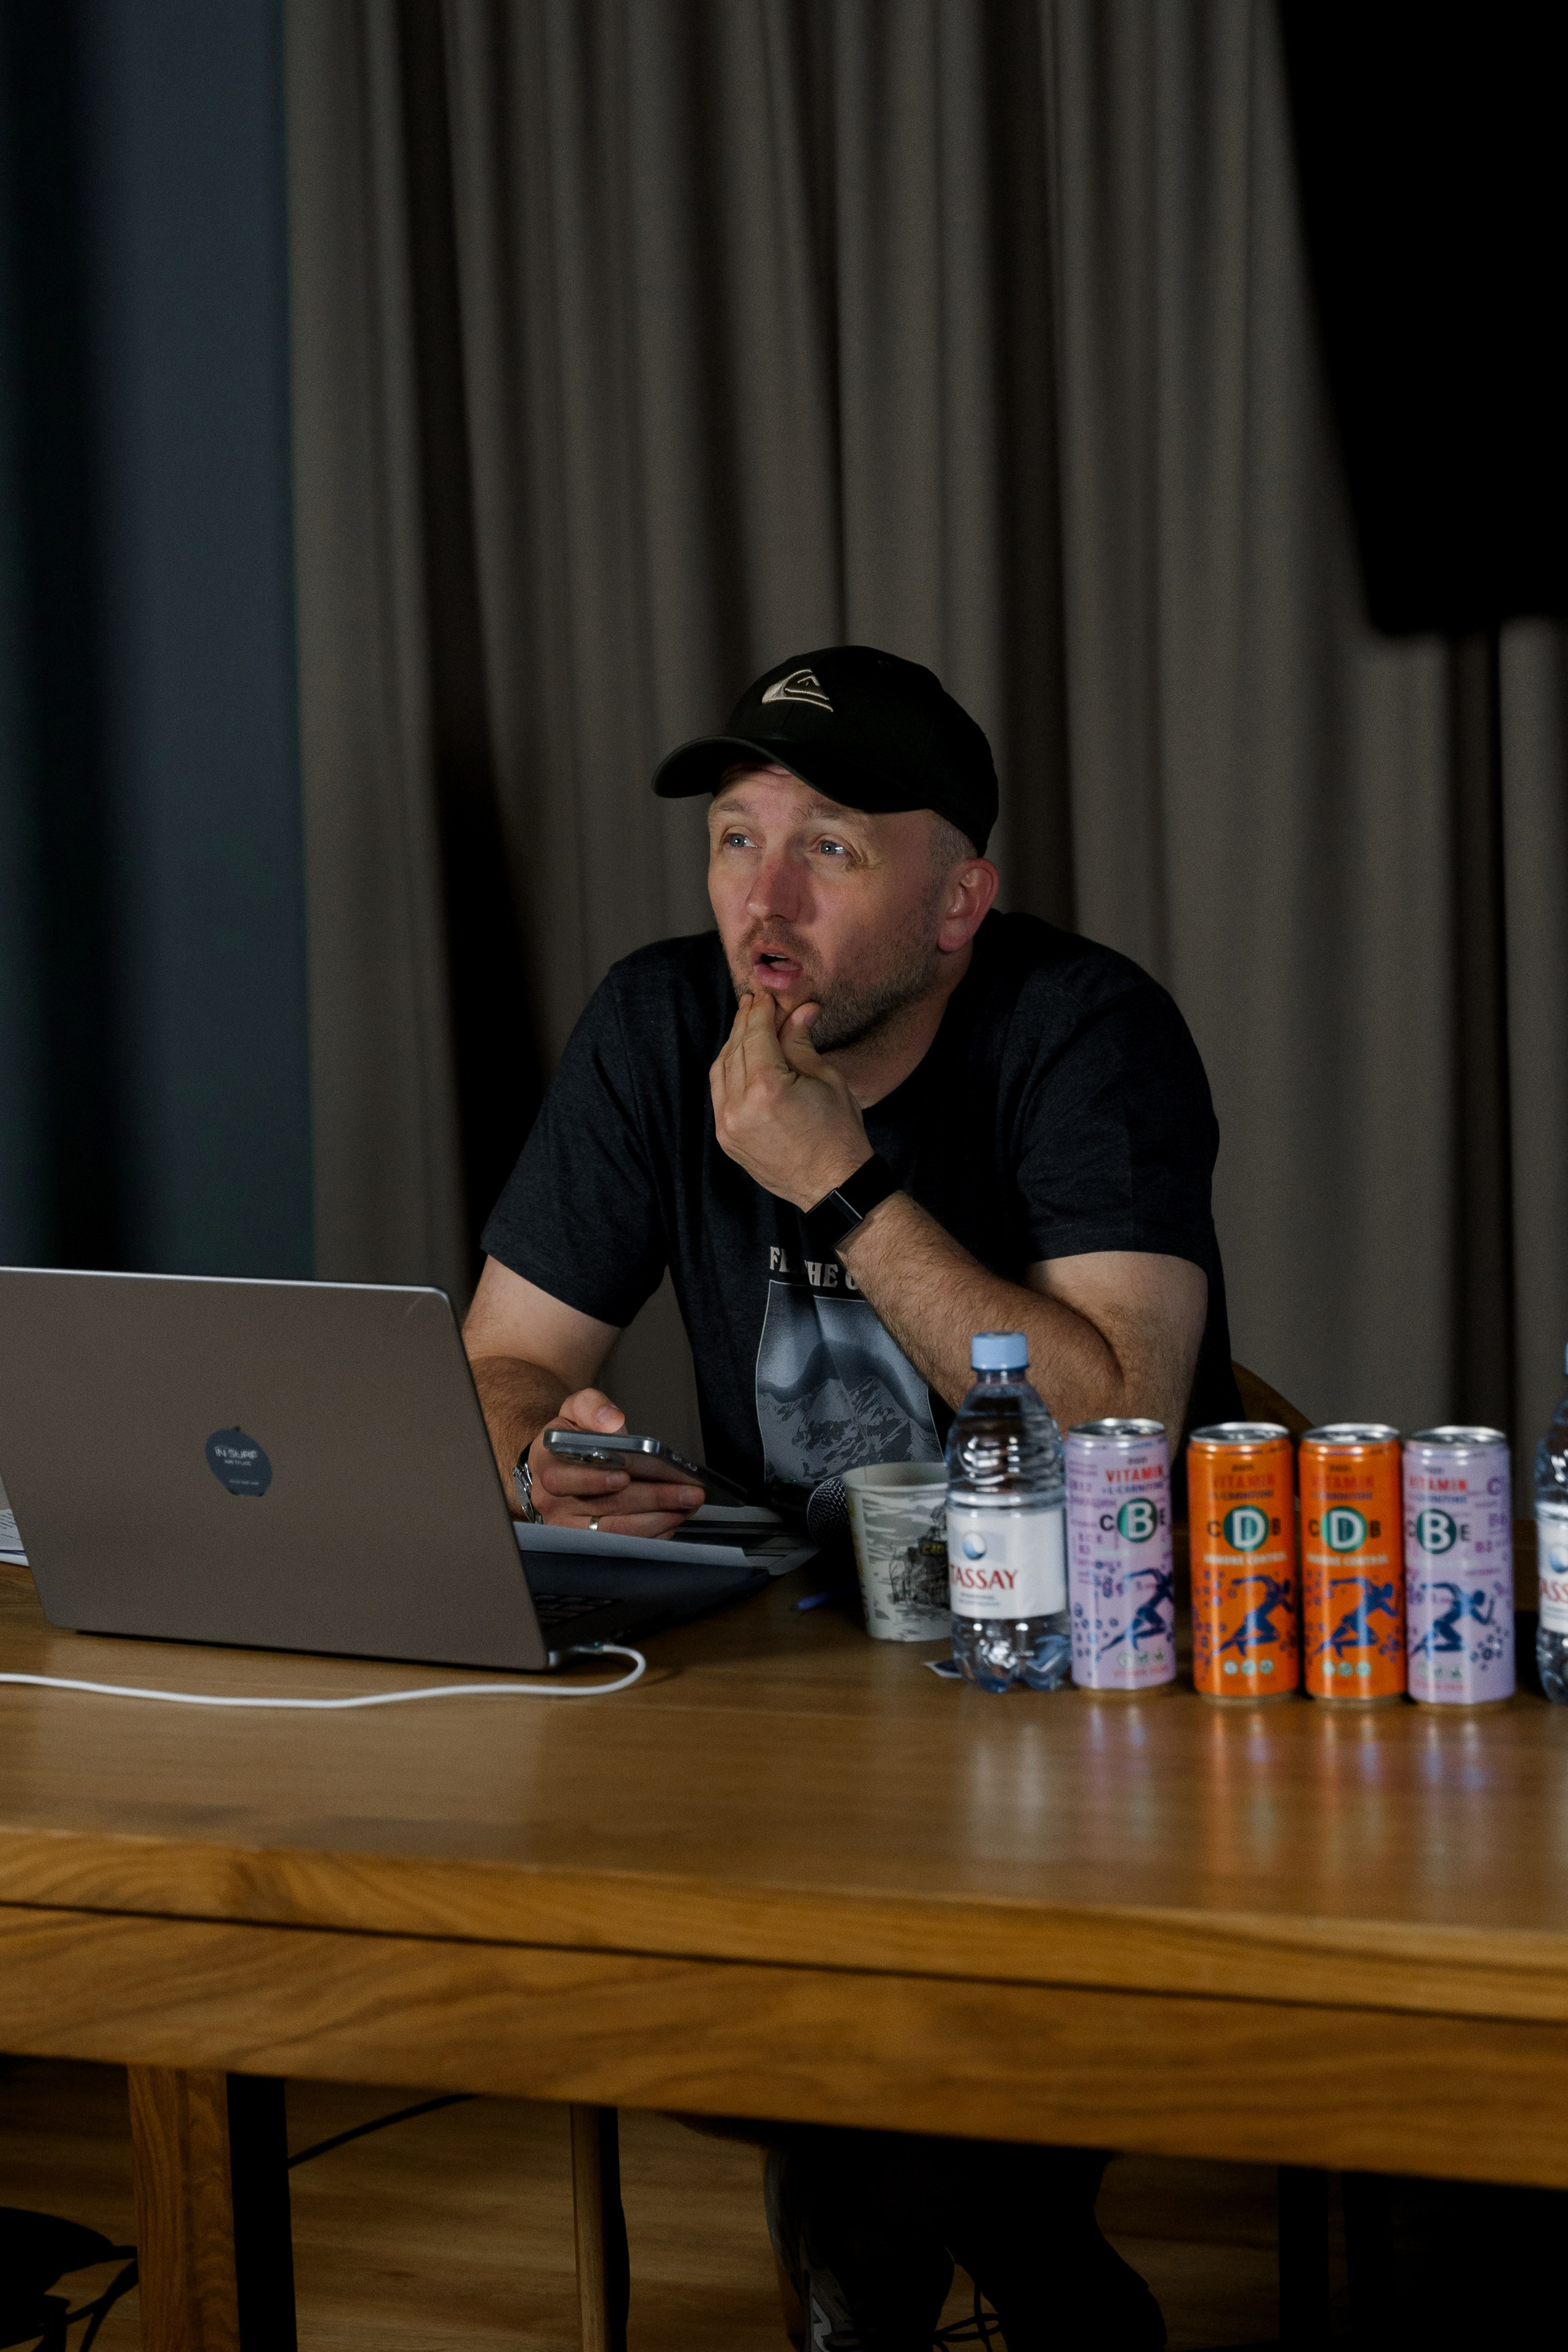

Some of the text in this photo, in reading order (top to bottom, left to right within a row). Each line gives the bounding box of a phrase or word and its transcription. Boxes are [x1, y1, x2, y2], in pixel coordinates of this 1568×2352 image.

[804, 1259, 839, 1288] HE
[1105, 1464, 1163, 1482] VITAMIN
[1127, 1501, 1154, 1539] B
[1232, 1509, 1265, 1548] D
[1330, 1509, 1365, 1550] D
[1422, 1512, 1452, 1551] B
